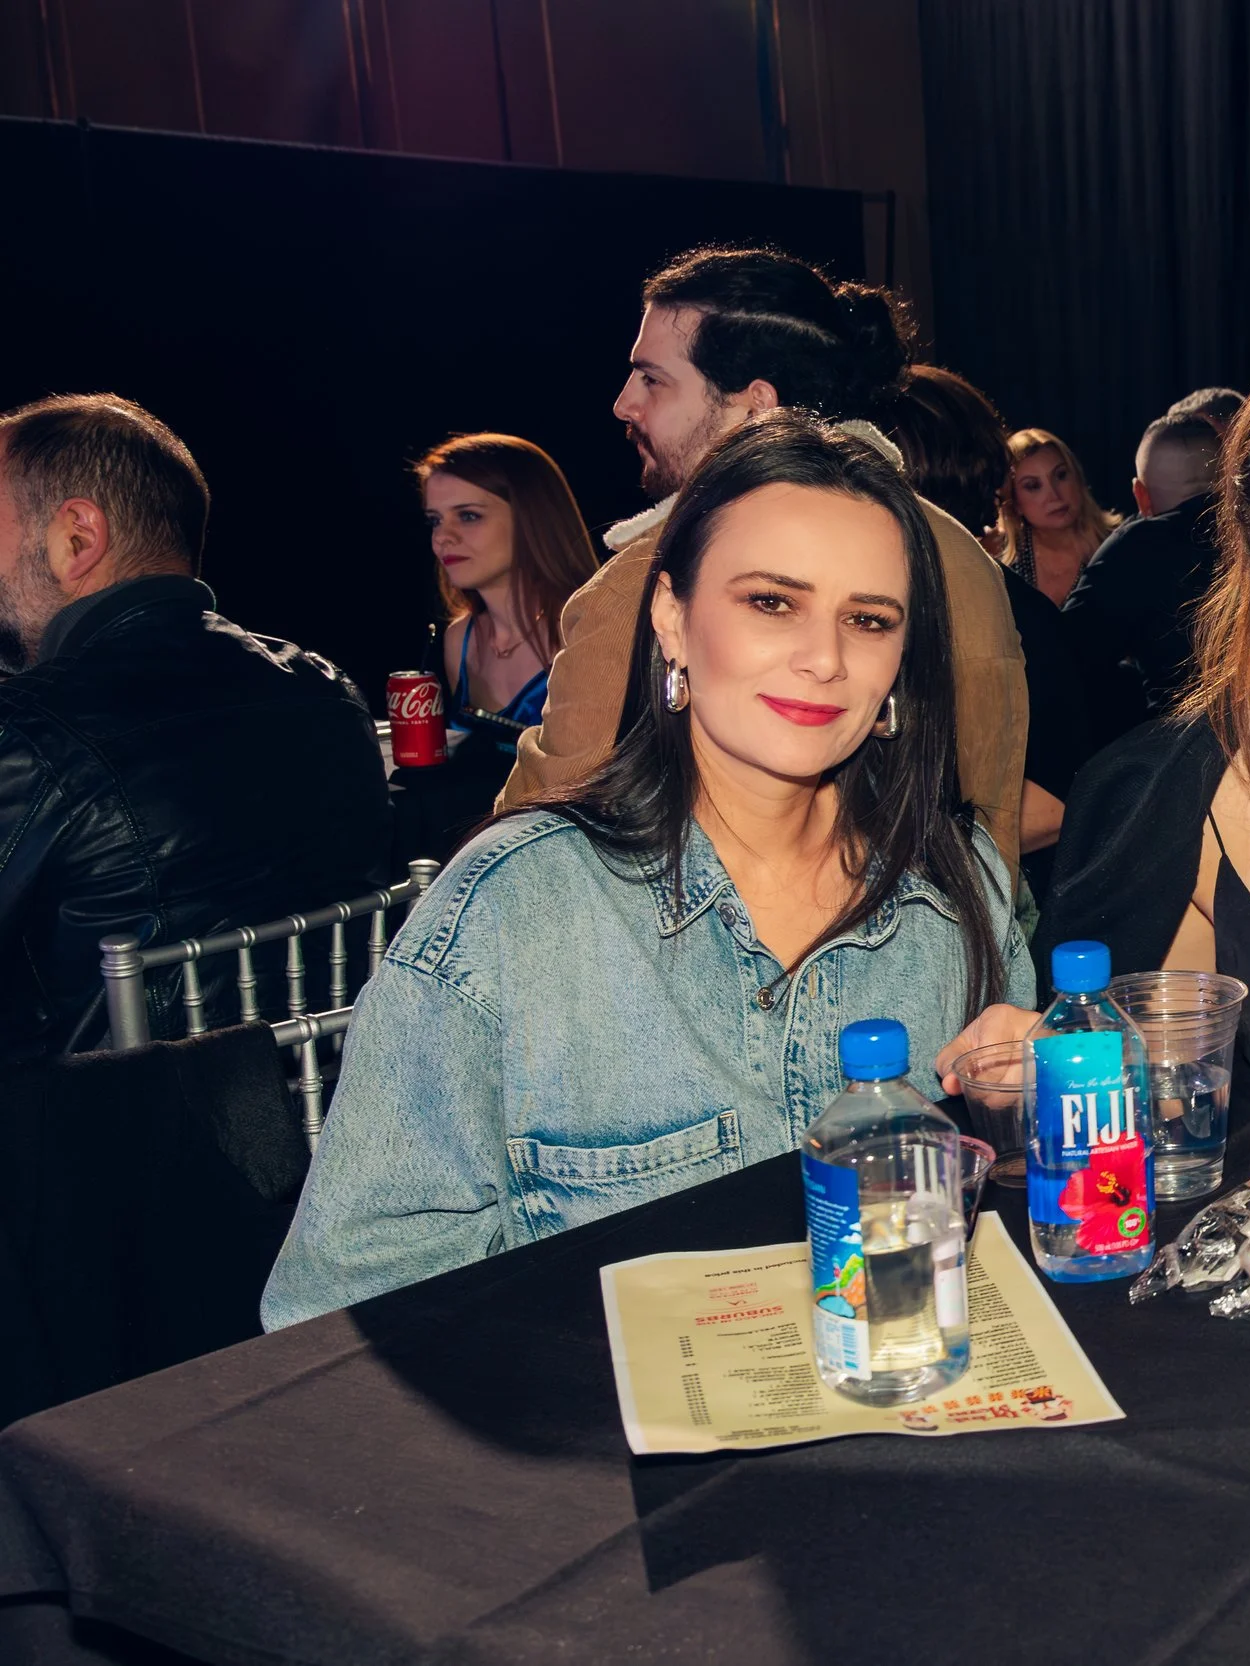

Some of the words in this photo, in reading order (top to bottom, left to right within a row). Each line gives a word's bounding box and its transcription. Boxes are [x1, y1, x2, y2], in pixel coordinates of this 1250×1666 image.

[1060, 1087, 1137, 1148] FIJI
[1062, 1149, 1089, 1157] NATURAL
[695, 1305, 783, 1322] SUBURBS
